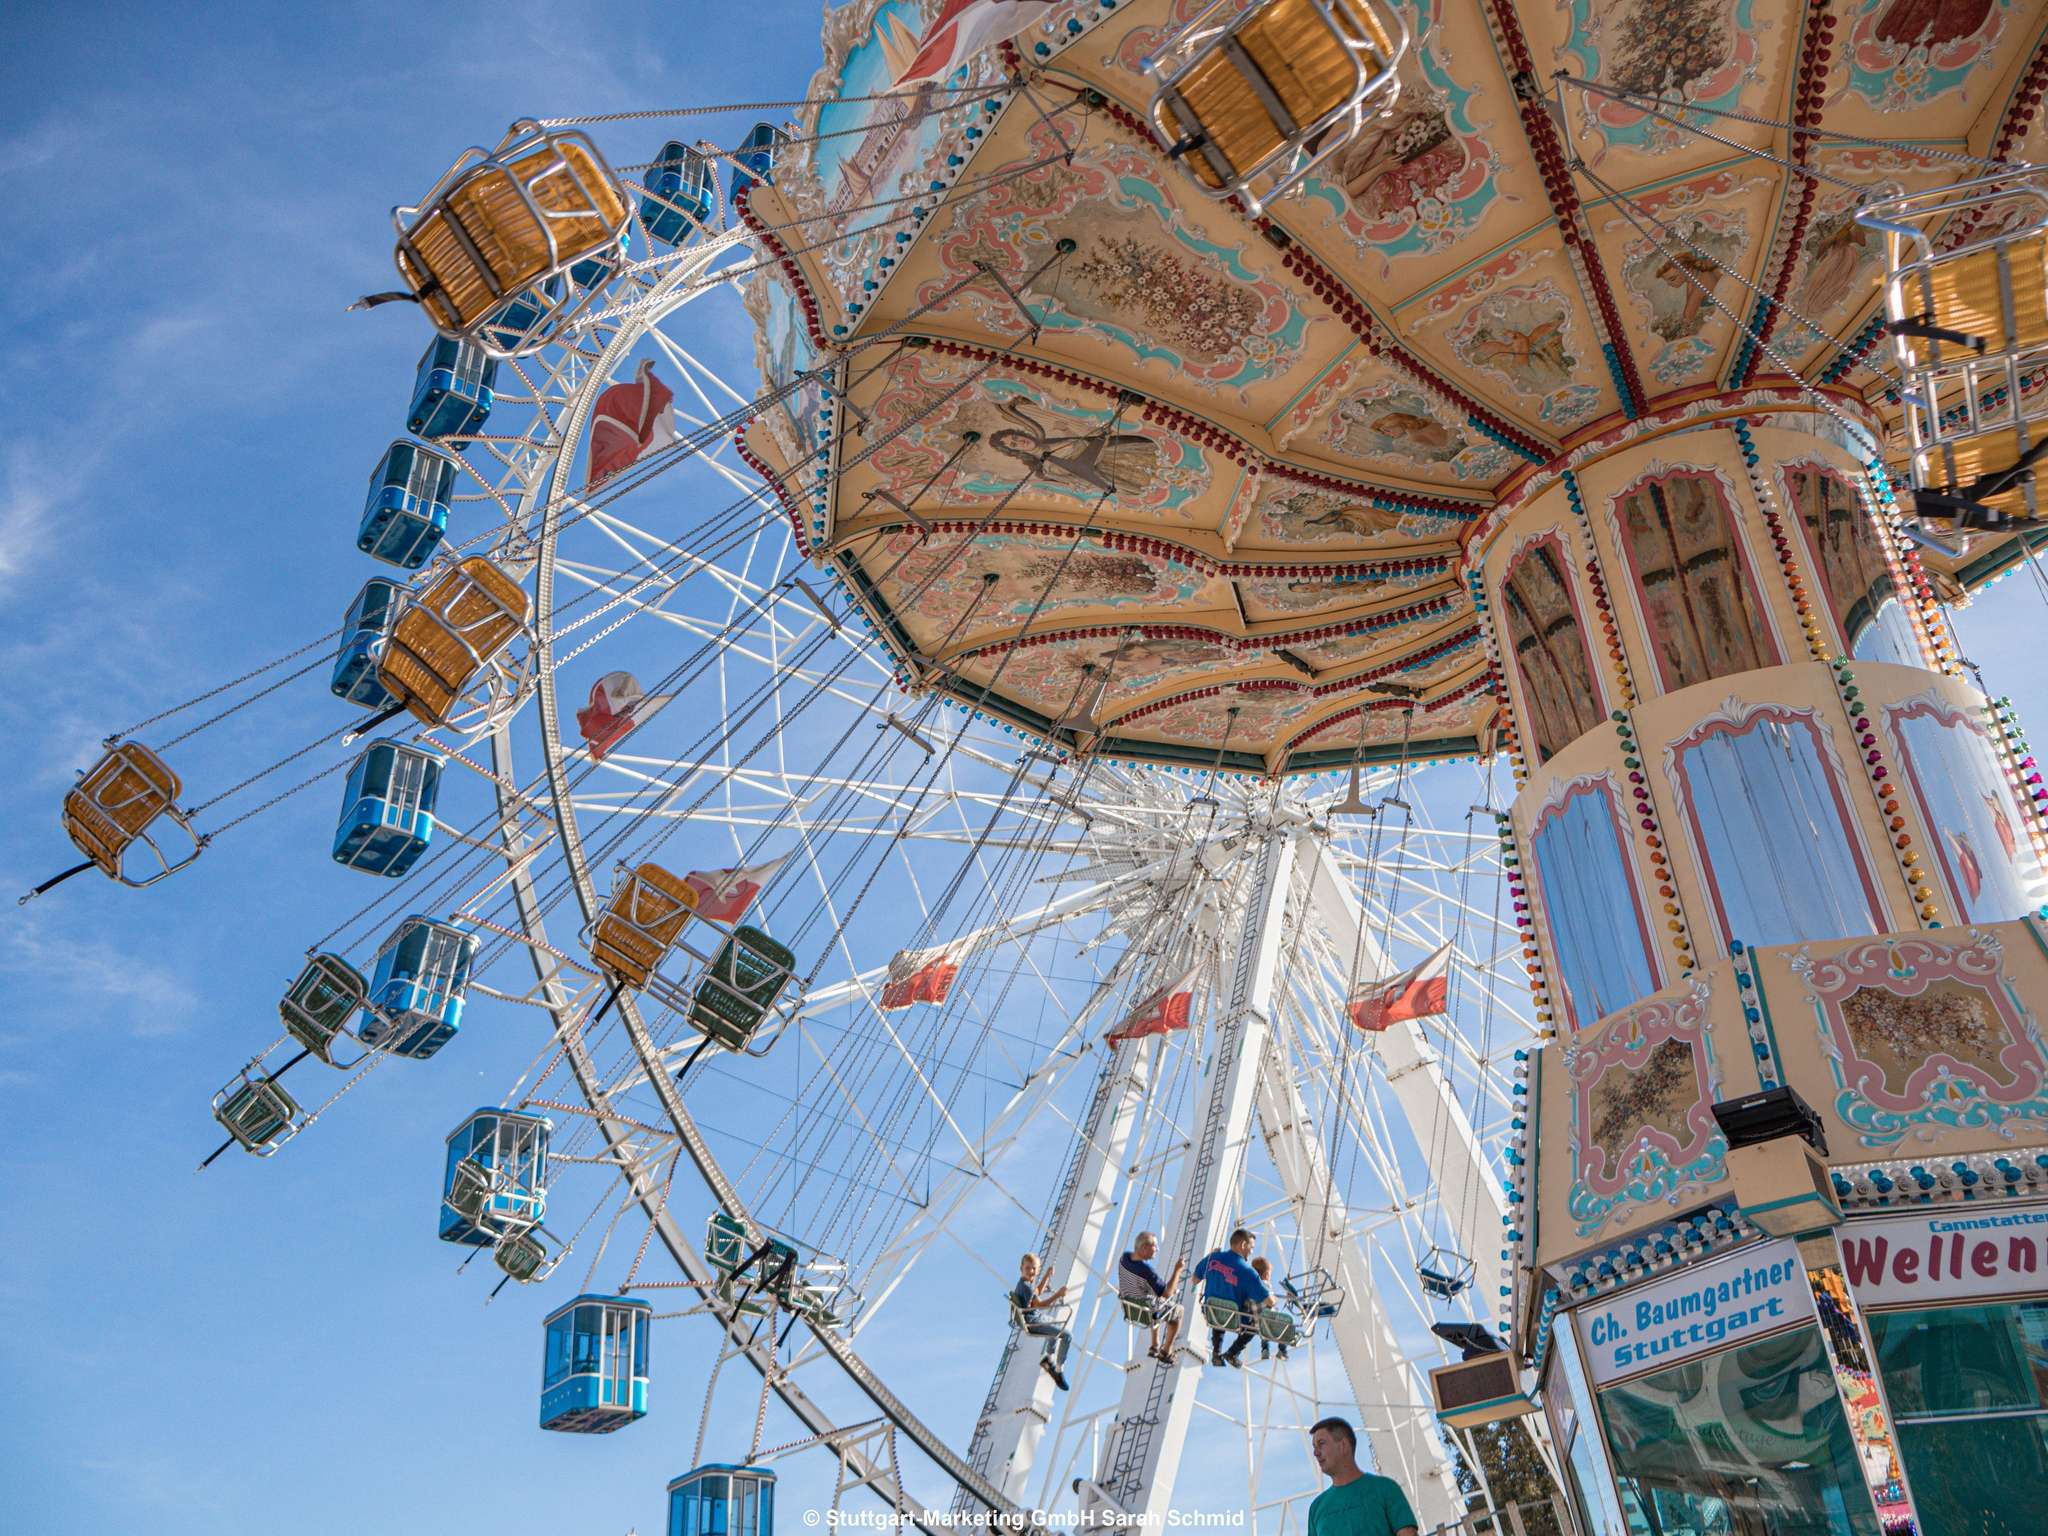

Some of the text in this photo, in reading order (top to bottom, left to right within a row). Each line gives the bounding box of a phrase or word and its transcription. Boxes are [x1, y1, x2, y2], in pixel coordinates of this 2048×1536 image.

[1842, 1233, 2048, 1287] Wellen
[1591, 1258, 1794, 1346] Ch. Baumgartner
[1614, 1297, 1784, 1368] Stuttgart
